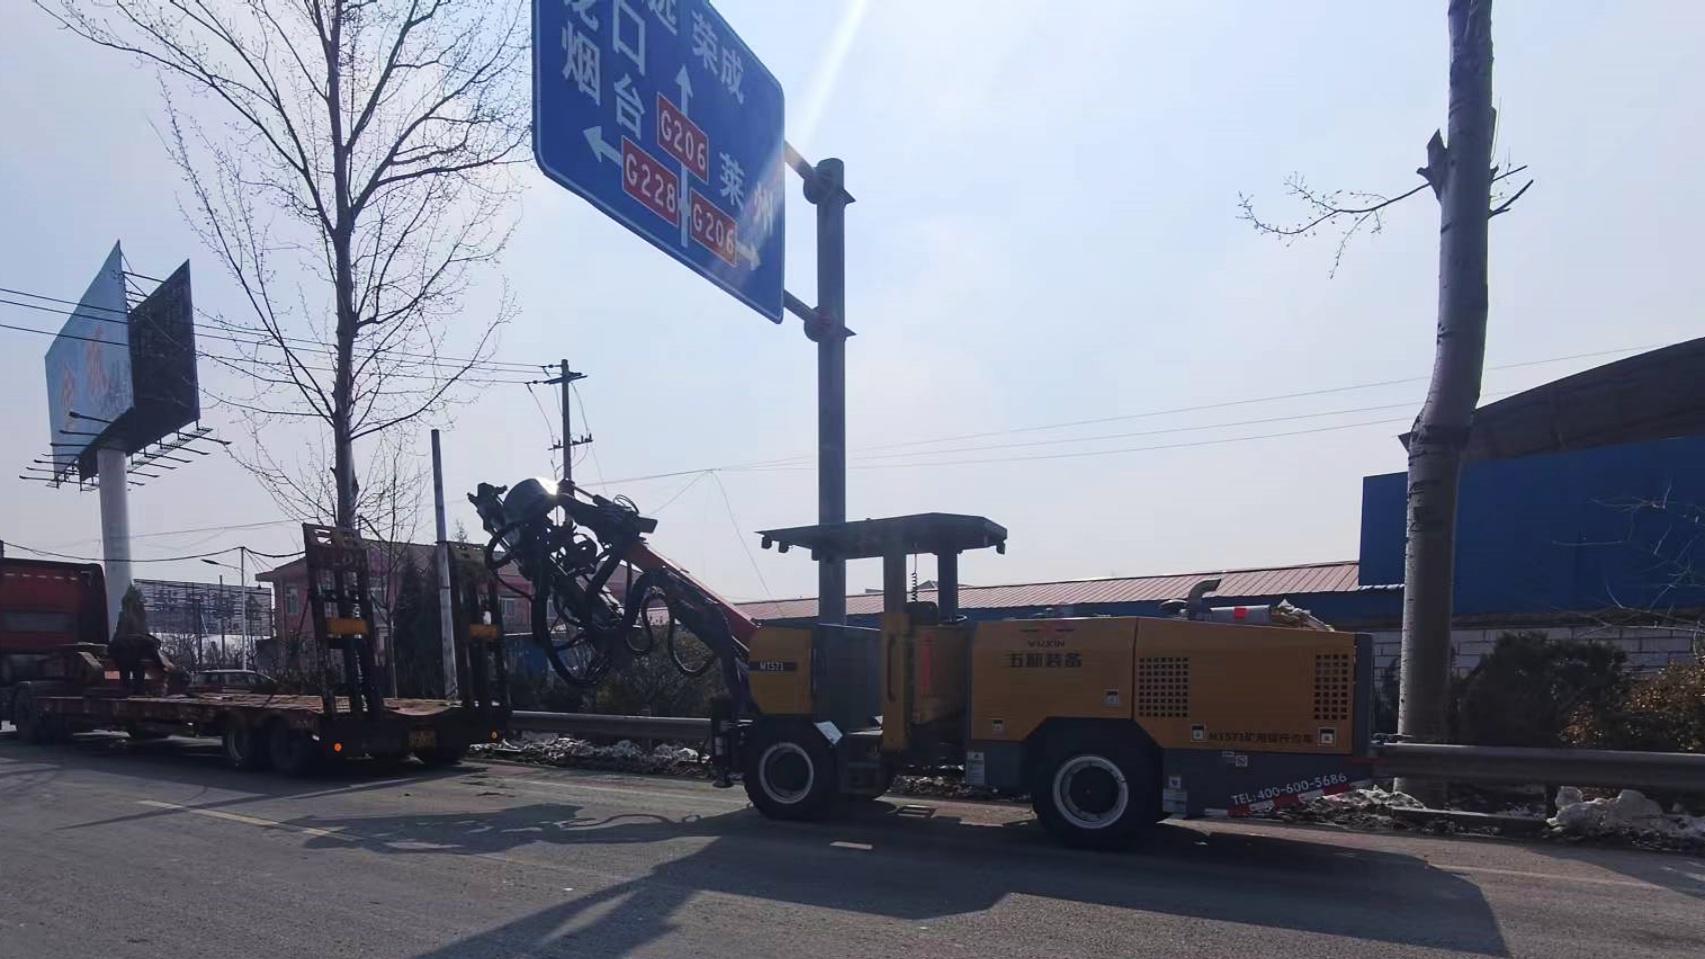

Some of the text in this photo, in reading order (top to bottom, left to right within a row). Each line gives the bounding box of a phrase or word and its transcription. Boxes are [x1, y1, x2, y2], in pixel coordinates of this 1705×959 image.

[564, 0, 645, 76] 口
[691, 9, 744, 104] 荣成
[562, 21, 645, 140] 烟台
[659, 109, 706, 173] G206
[625, 152, 676, 213] G228
[692, 202, 735, 257] G206
[1230, 772, 1347, 805] TEL:400-600-5686
